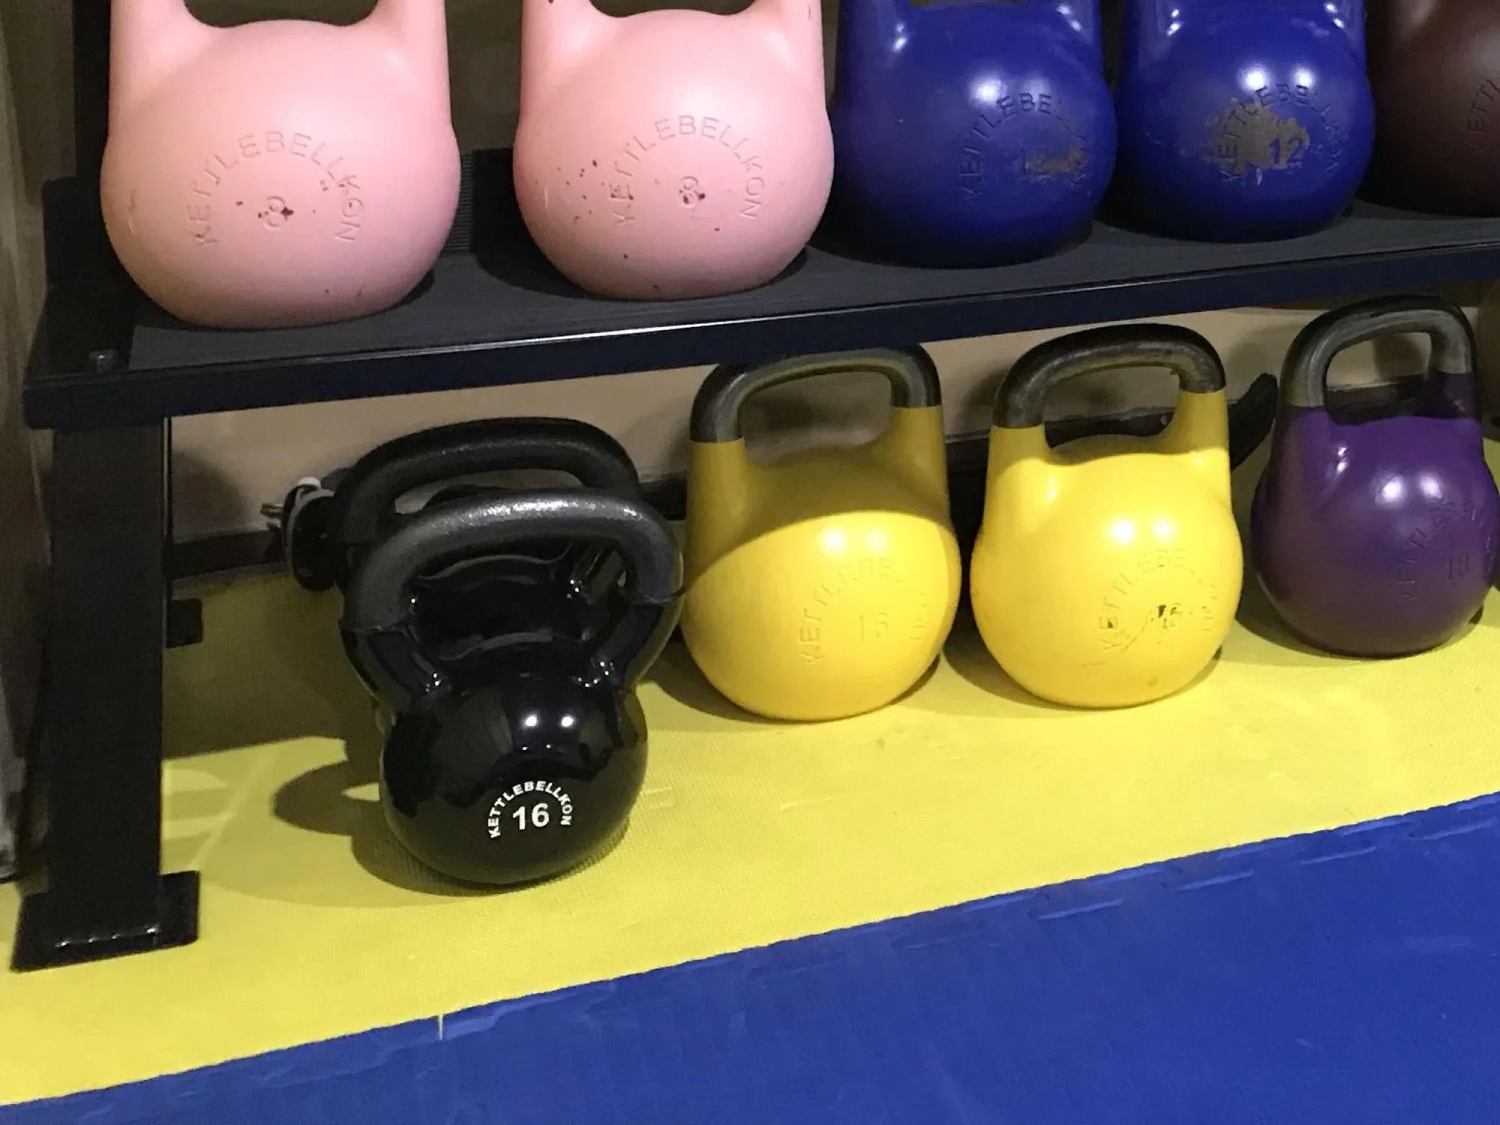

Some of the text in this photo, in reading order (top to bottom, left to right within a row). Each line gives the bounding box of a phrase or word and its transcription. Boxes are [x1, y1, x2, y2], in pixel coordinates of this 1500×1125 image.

[186, 130, 364, 246] KETTLEBELLKON
[608, 114, 765, 221] KETTLEBELLKON
[487, 780, 573, 838] KETTLEBELLKON
[512, 802, 550, 830] 16
